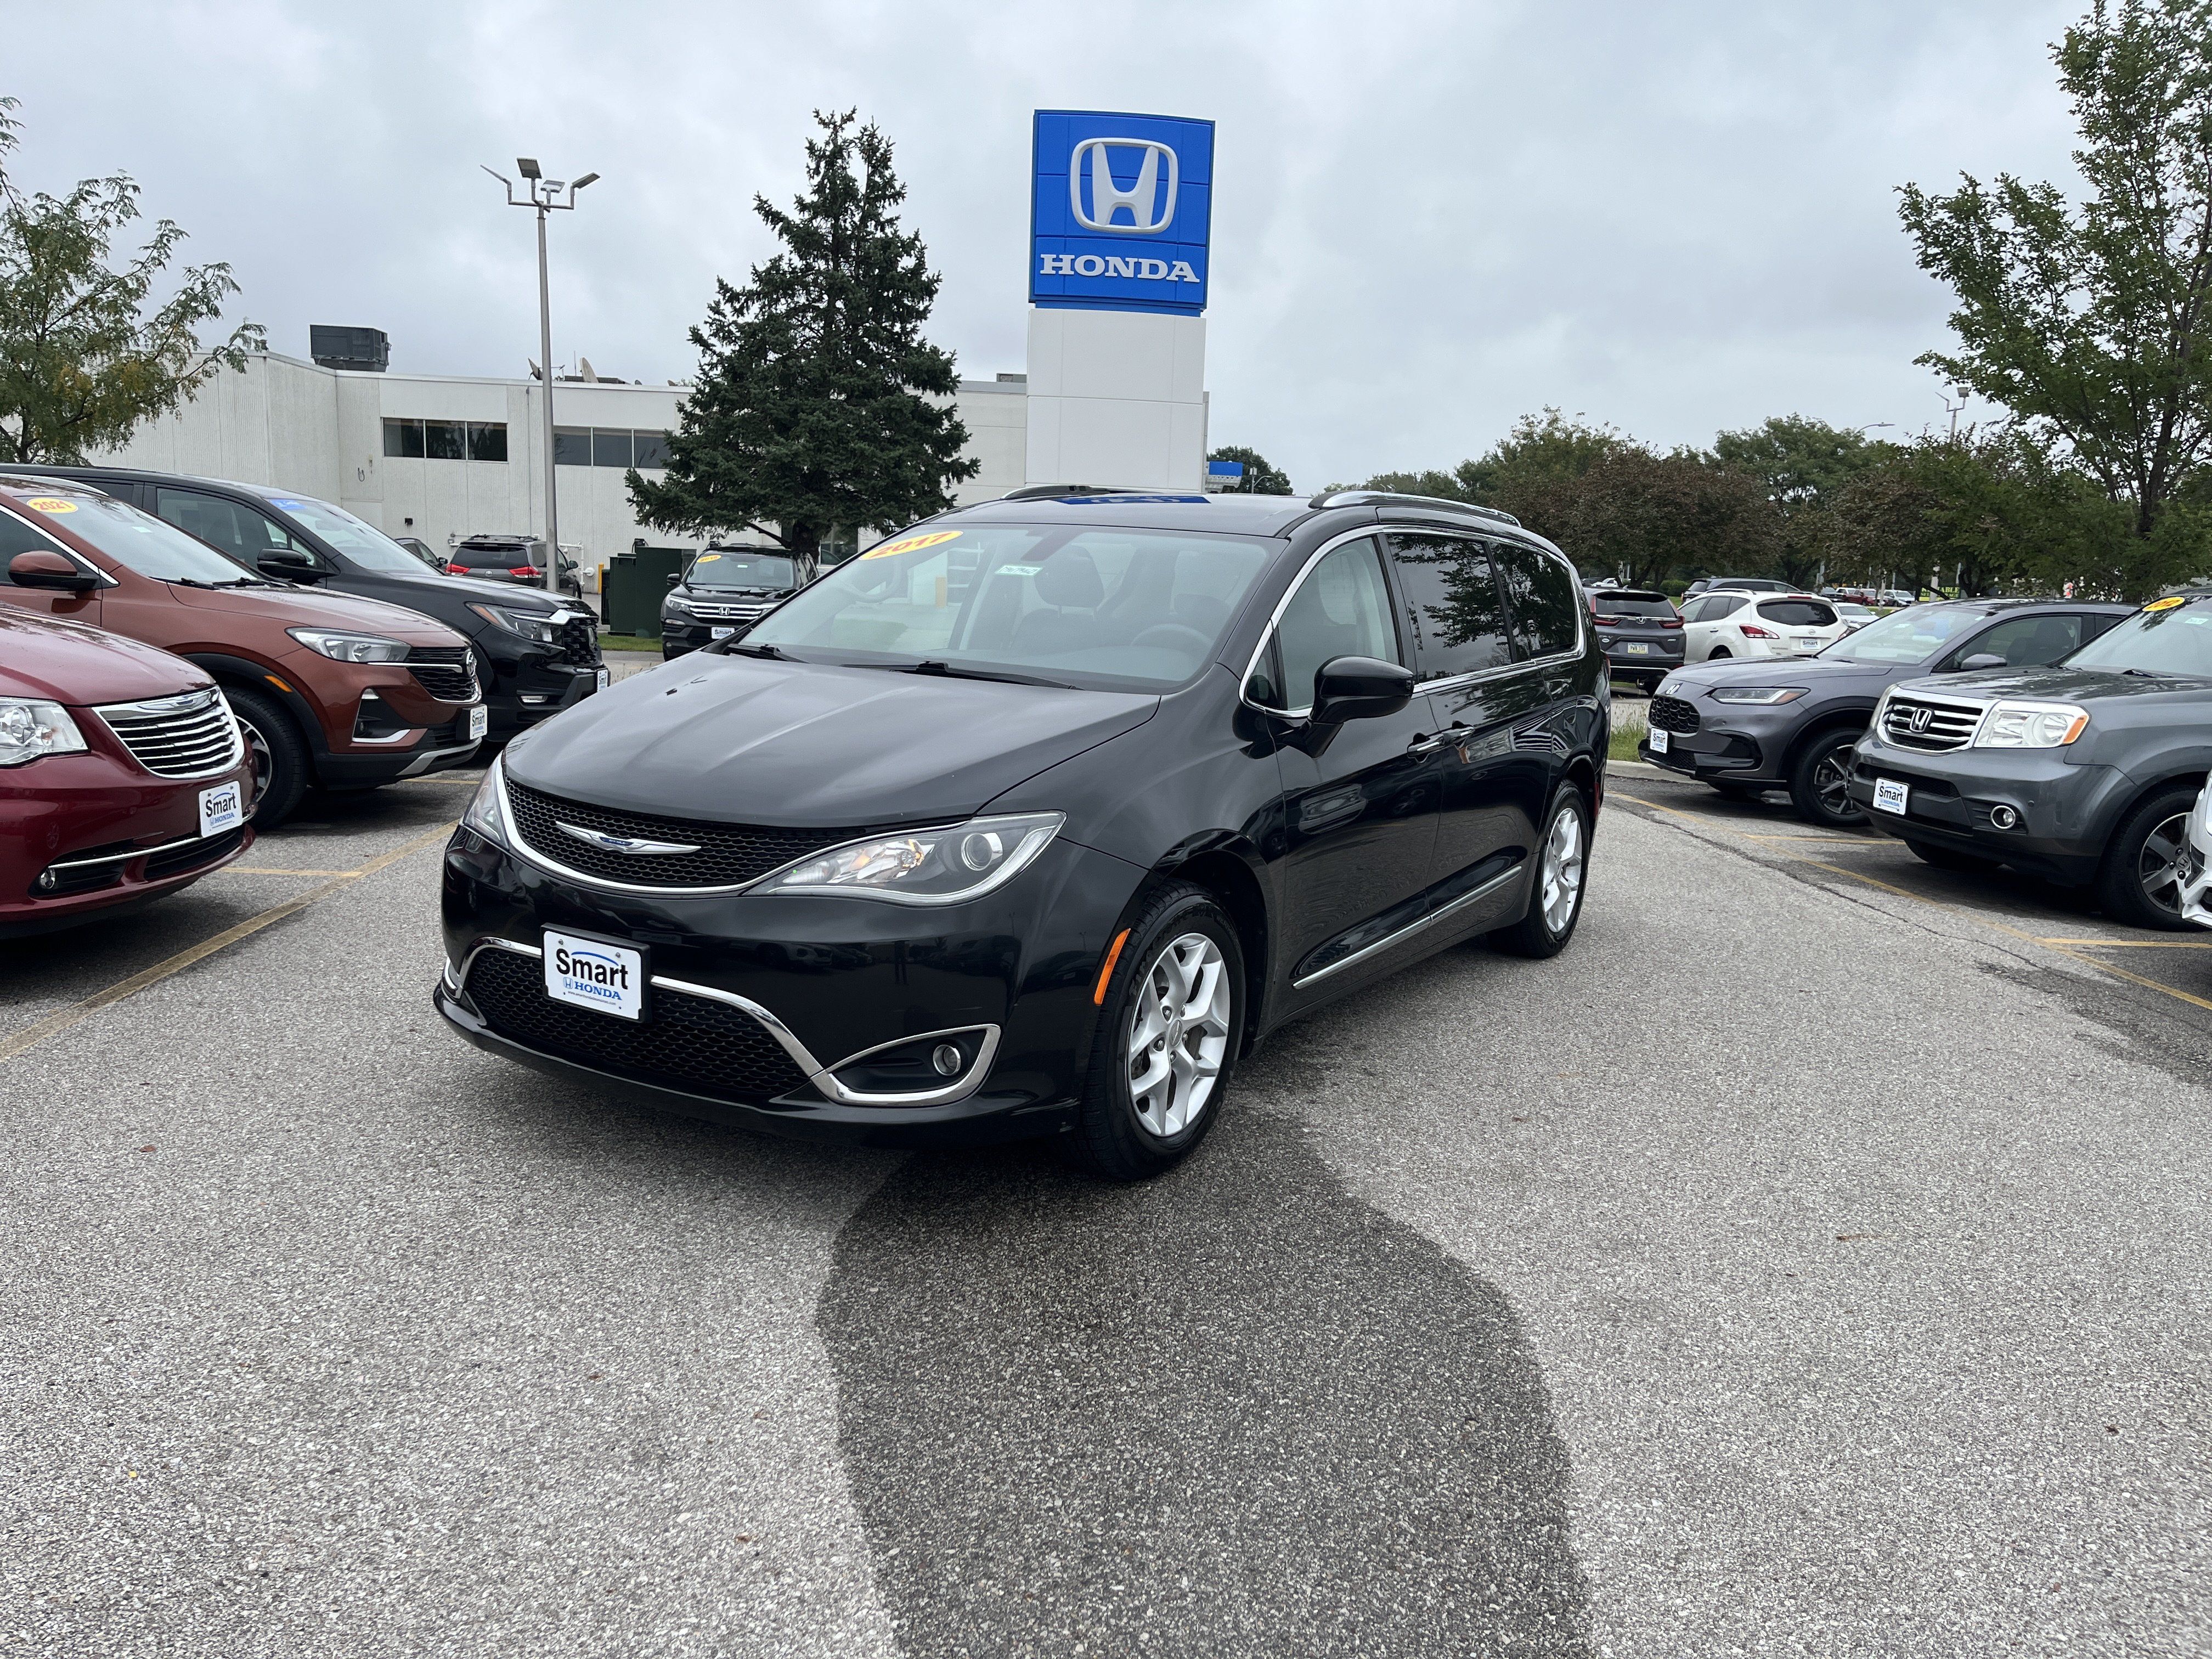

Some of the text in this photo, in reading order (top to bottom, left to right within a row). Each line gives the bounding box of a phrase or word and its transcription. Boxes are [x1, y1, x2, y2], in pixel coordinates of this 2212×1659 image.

[1040, 253, 1200, 283] HONDA
[33, 501, 72, 510] 2021
[869, 532, 953, 558] 2017
[472, 713, 485, 727] Smart
[1879, 786, 1903, 803] Smart
[206, 793, 236, 817] Smart
[215, 812, 235, 823] HONDA
[556, 948, 628, 990] Smart
[574, 981, 623, 1000] HONDA
